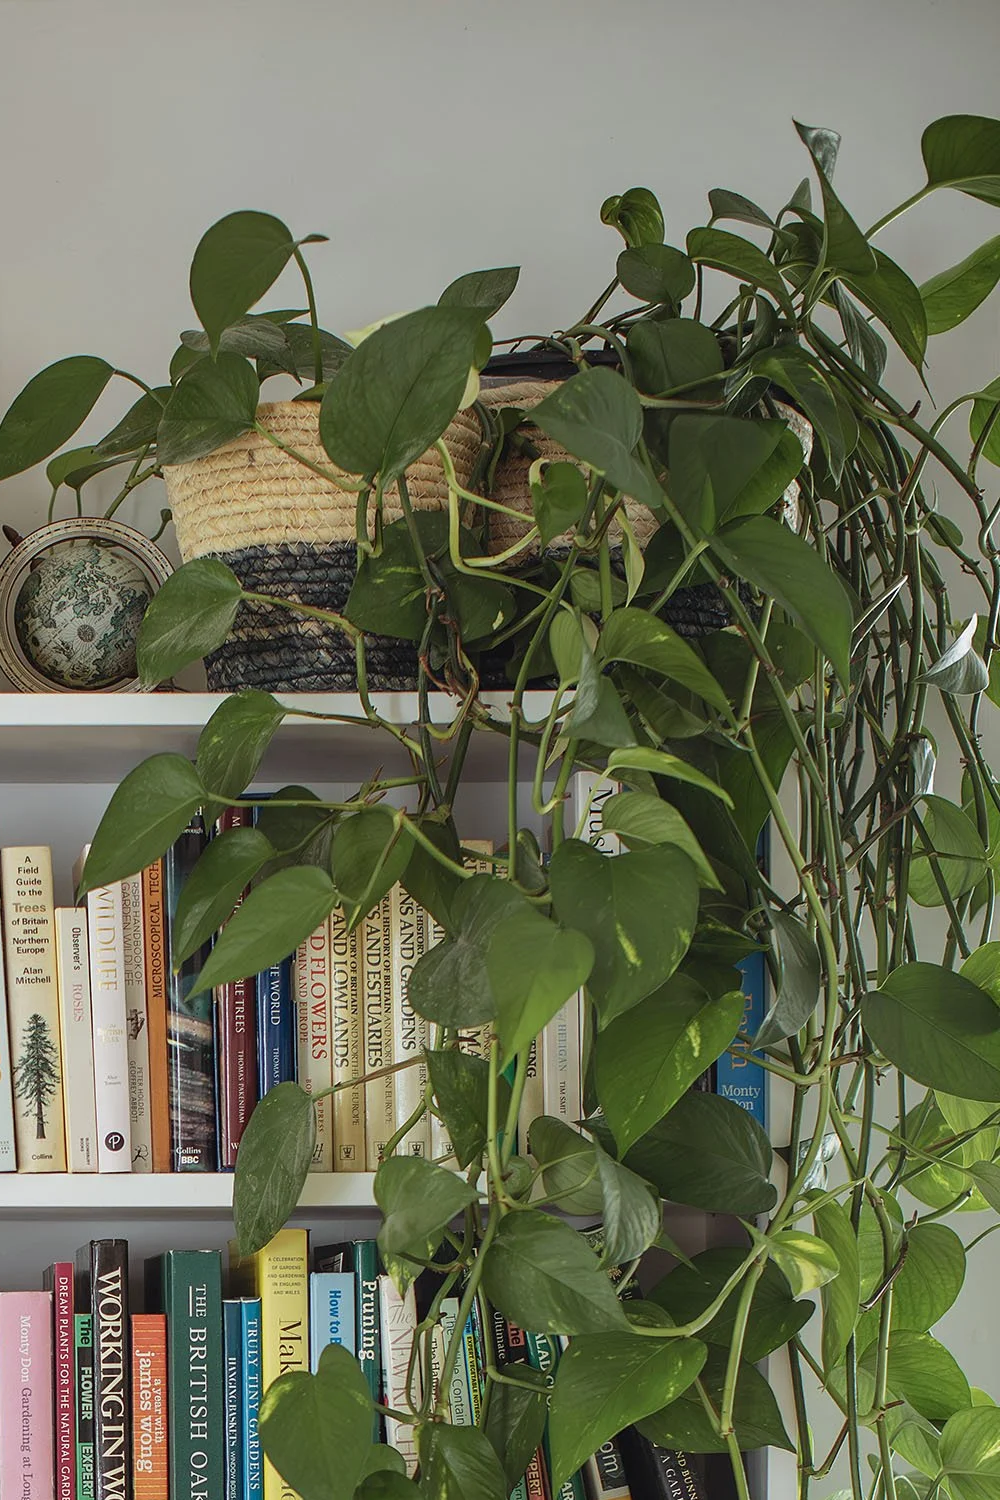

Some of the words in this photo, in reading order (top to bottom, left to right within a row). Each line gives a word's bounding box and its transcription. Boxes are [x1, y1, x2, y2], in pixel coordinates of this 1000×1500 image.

[12, 902, 46, 913] Trees
[23, 967, 43, 975] Alan
[15, 976, 51, 985] Mitchell
[722, 1084, 760, 1098] Monty
[97, 1266, 126, 1419] WORKING
[189, 1326, 207, 1440] BRITISH
[100, 1423, 127, 1460] IN
